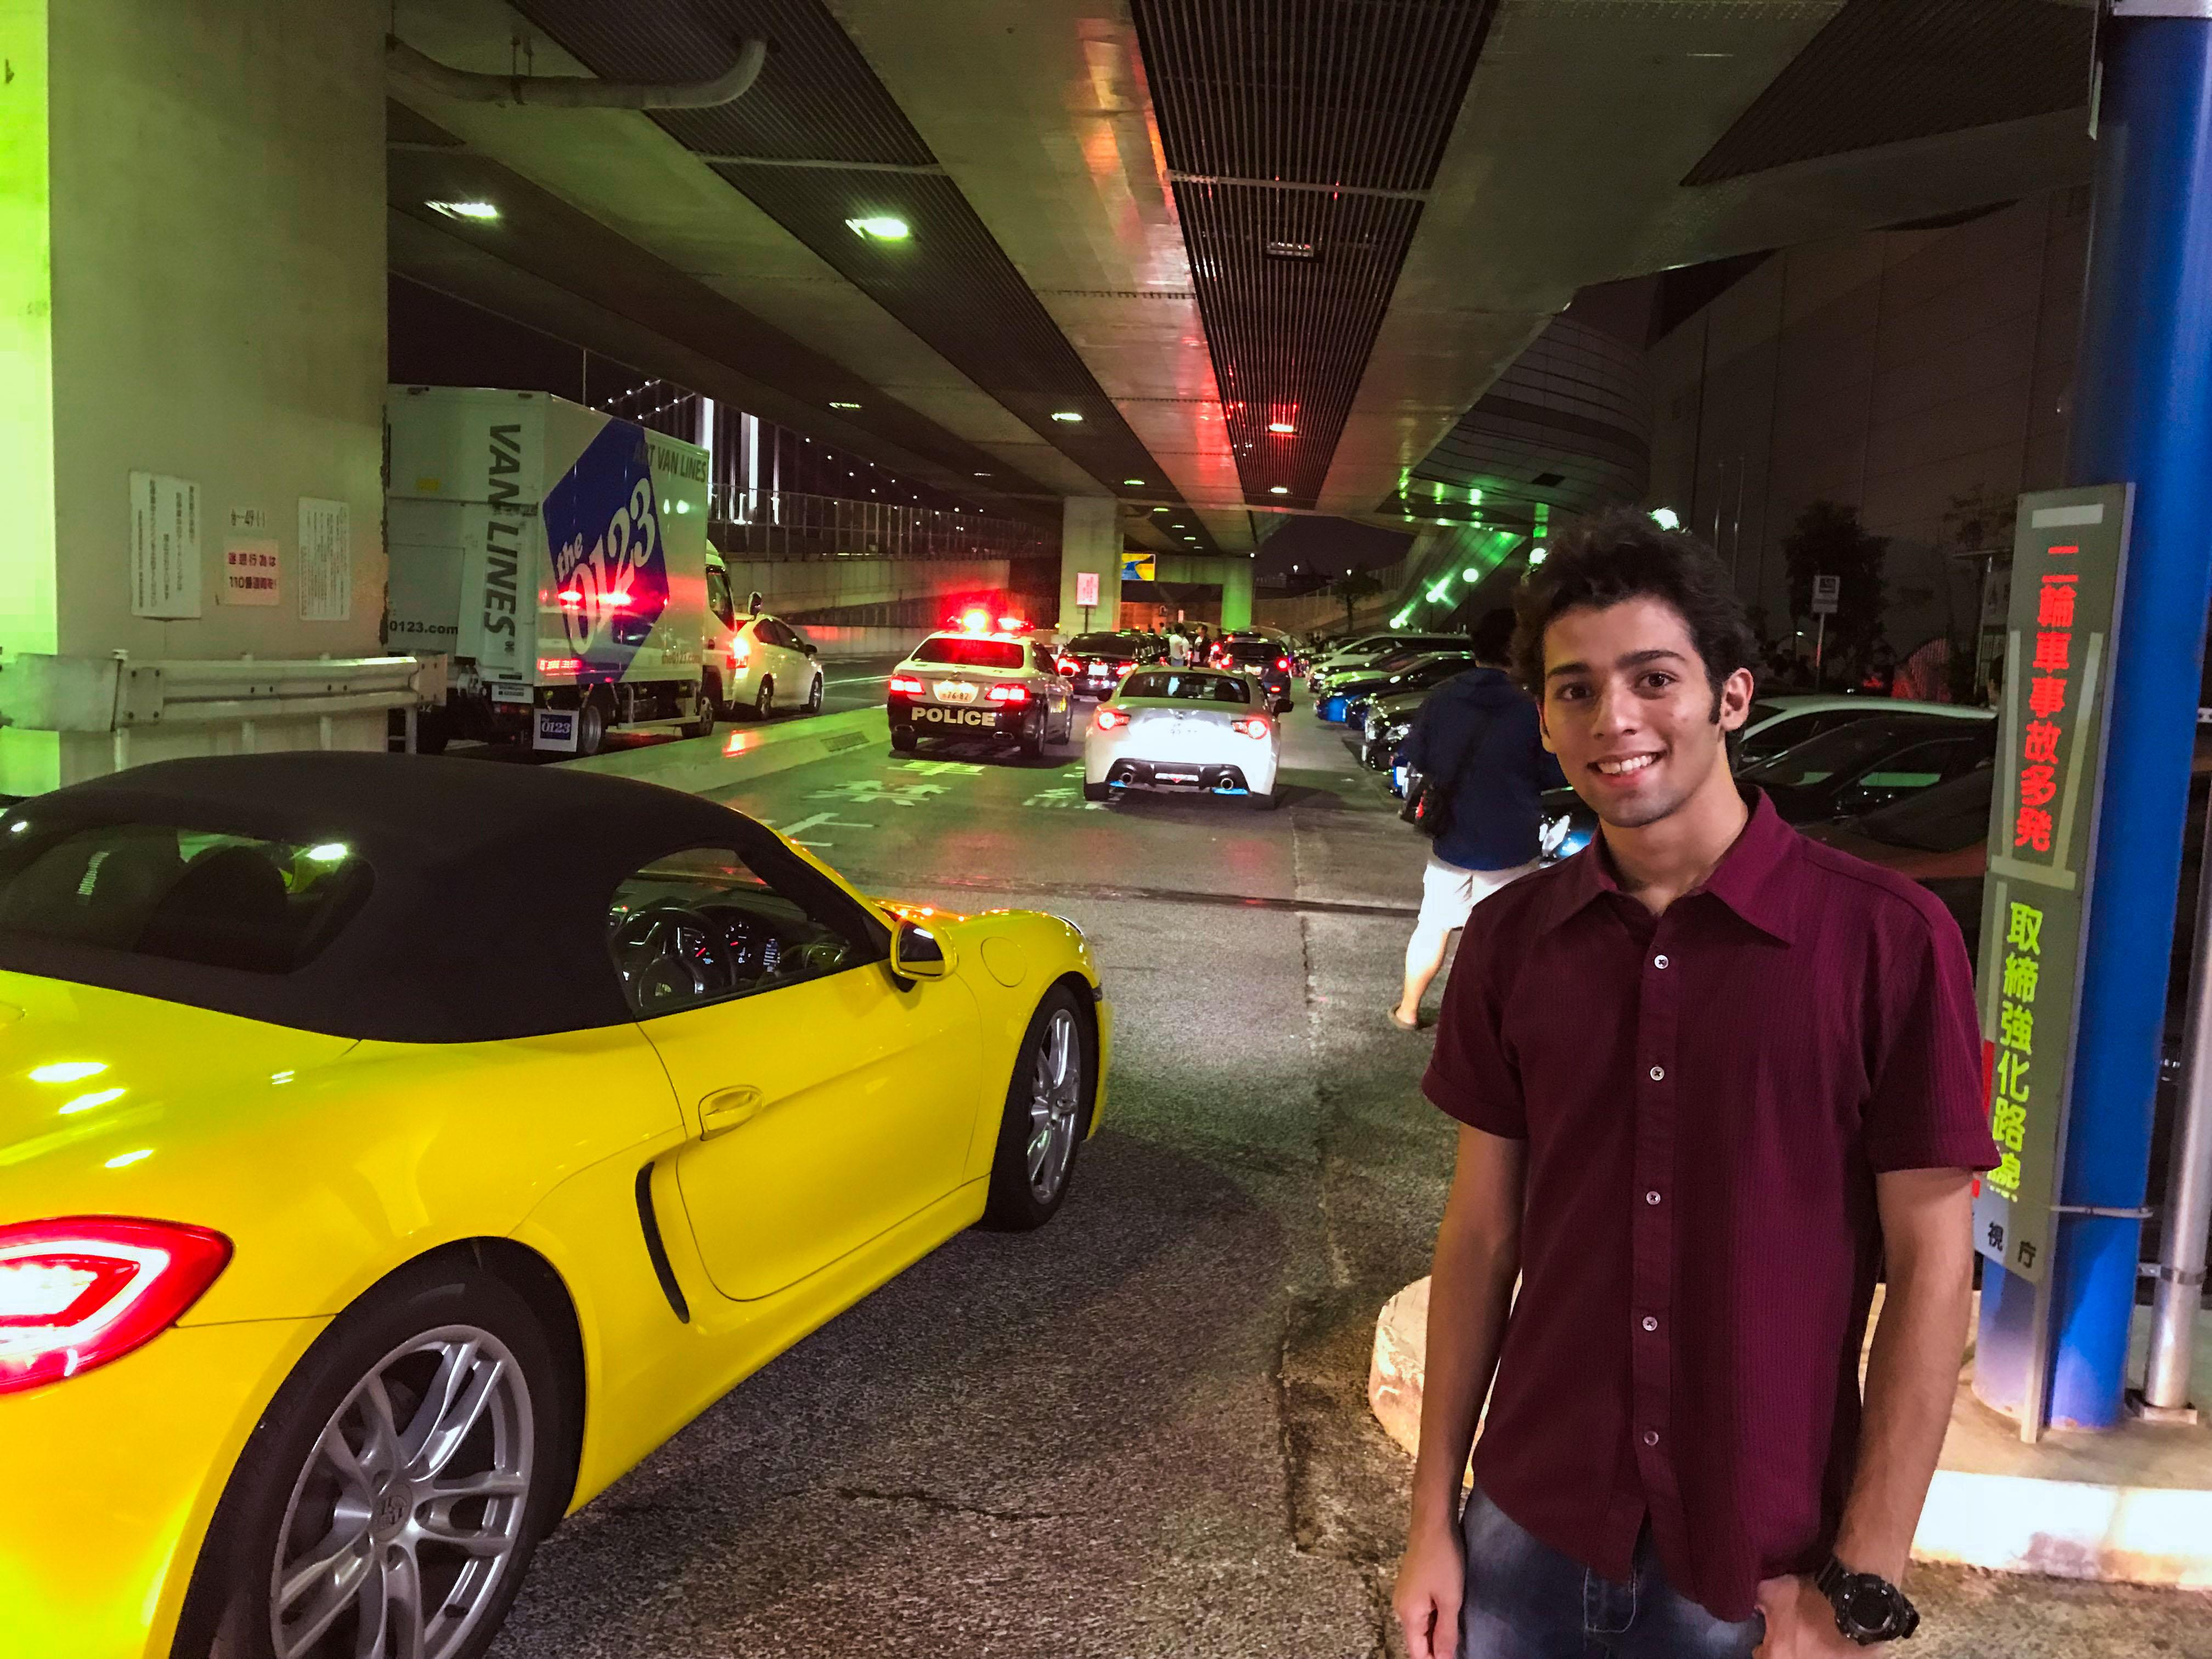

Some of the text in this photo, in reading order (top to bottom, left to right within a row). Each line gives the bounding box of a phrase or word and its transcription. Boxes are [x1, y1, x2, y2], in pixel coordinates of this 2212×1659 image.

[488, 425, 521, 509] VAN
[658, 447, 679, 475] VAN
[680, 455, 707, 483] LINES
[484, 521, 518, 637] LINES
[557, 532, 583, 583] the
[568, 477, 656, 655] 0123
[389, 621, 458, 635] 0123.com
[911, 707, 996, 726] POLICE
[2015, 545, 2079, 851] 二輪車事故多発
[541, 722, 571, 733] 0123
